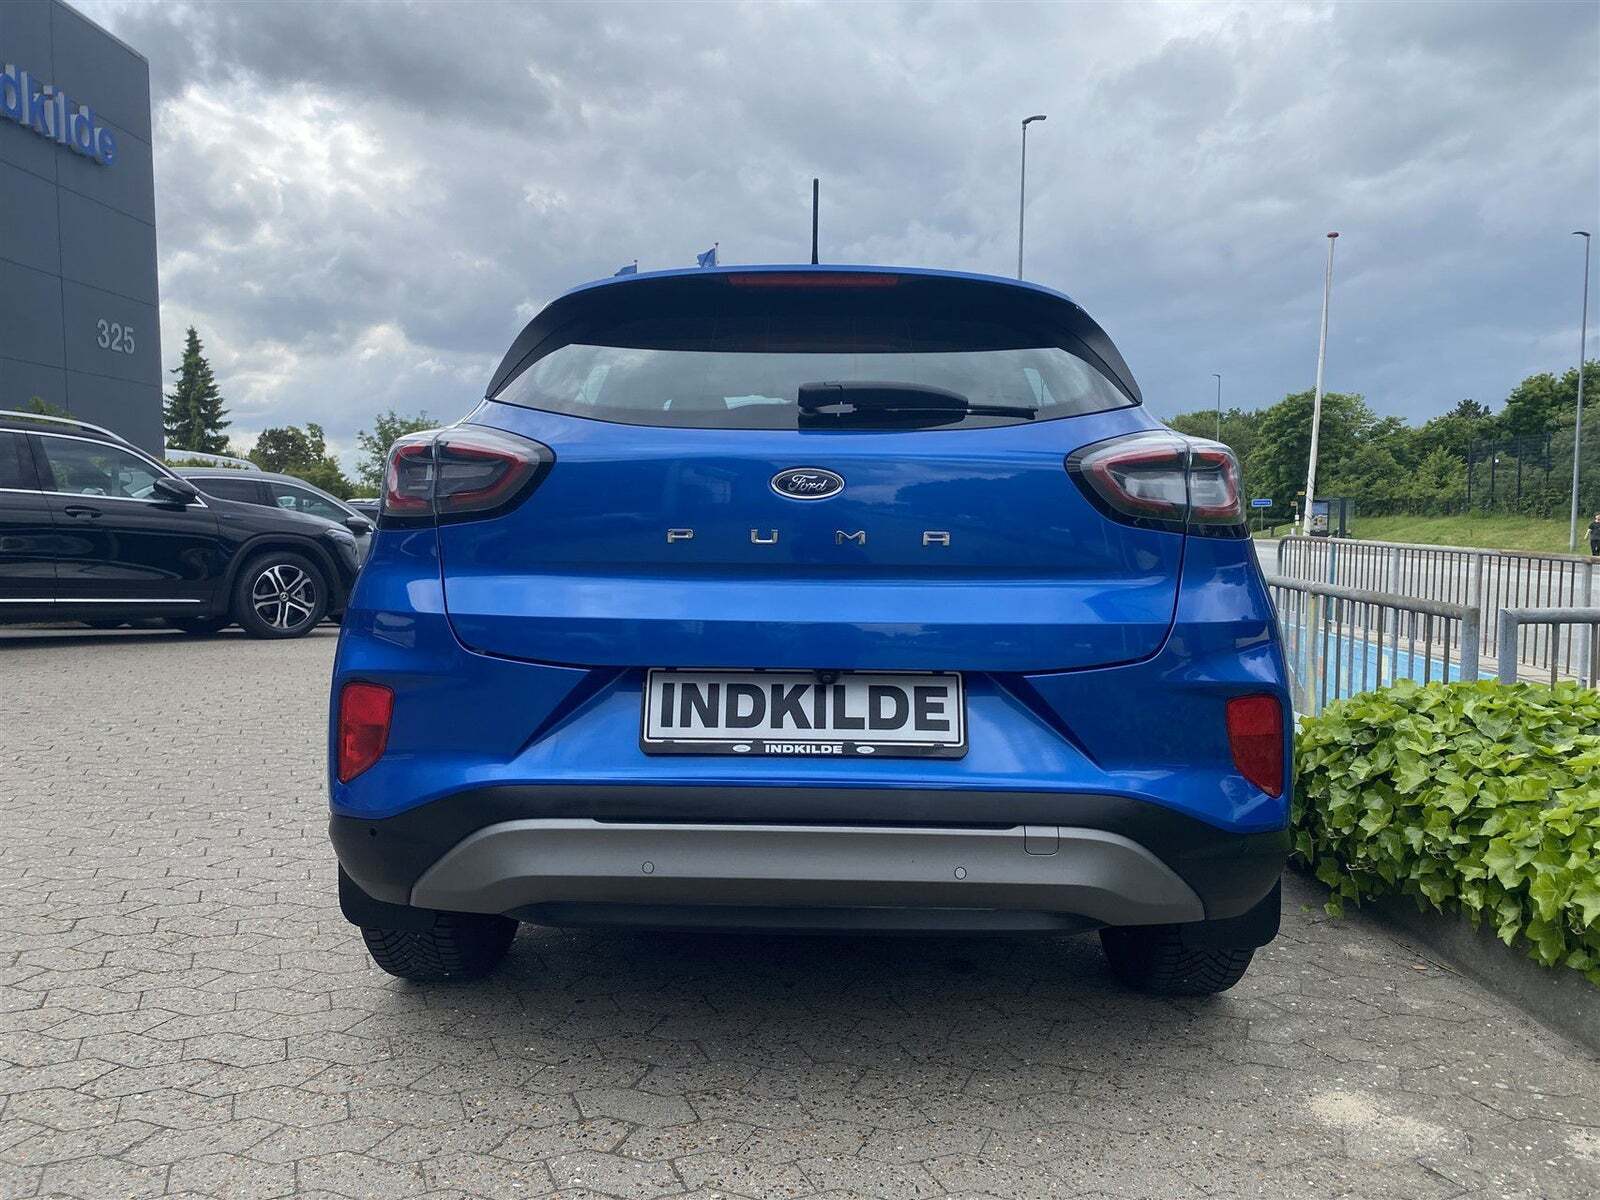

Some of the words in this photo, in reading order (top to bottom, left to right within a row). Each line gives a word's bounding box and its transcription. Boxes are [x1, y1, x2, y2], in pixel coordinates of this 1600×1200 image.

[97, 318, 136, 354] 325
[789, 474, 828, 492] Ford
[667, 528, 951, 547] PUMA
[659, 682, 951, 732] INDKILDE
[764, 743, 843, 755] INDKILDE
